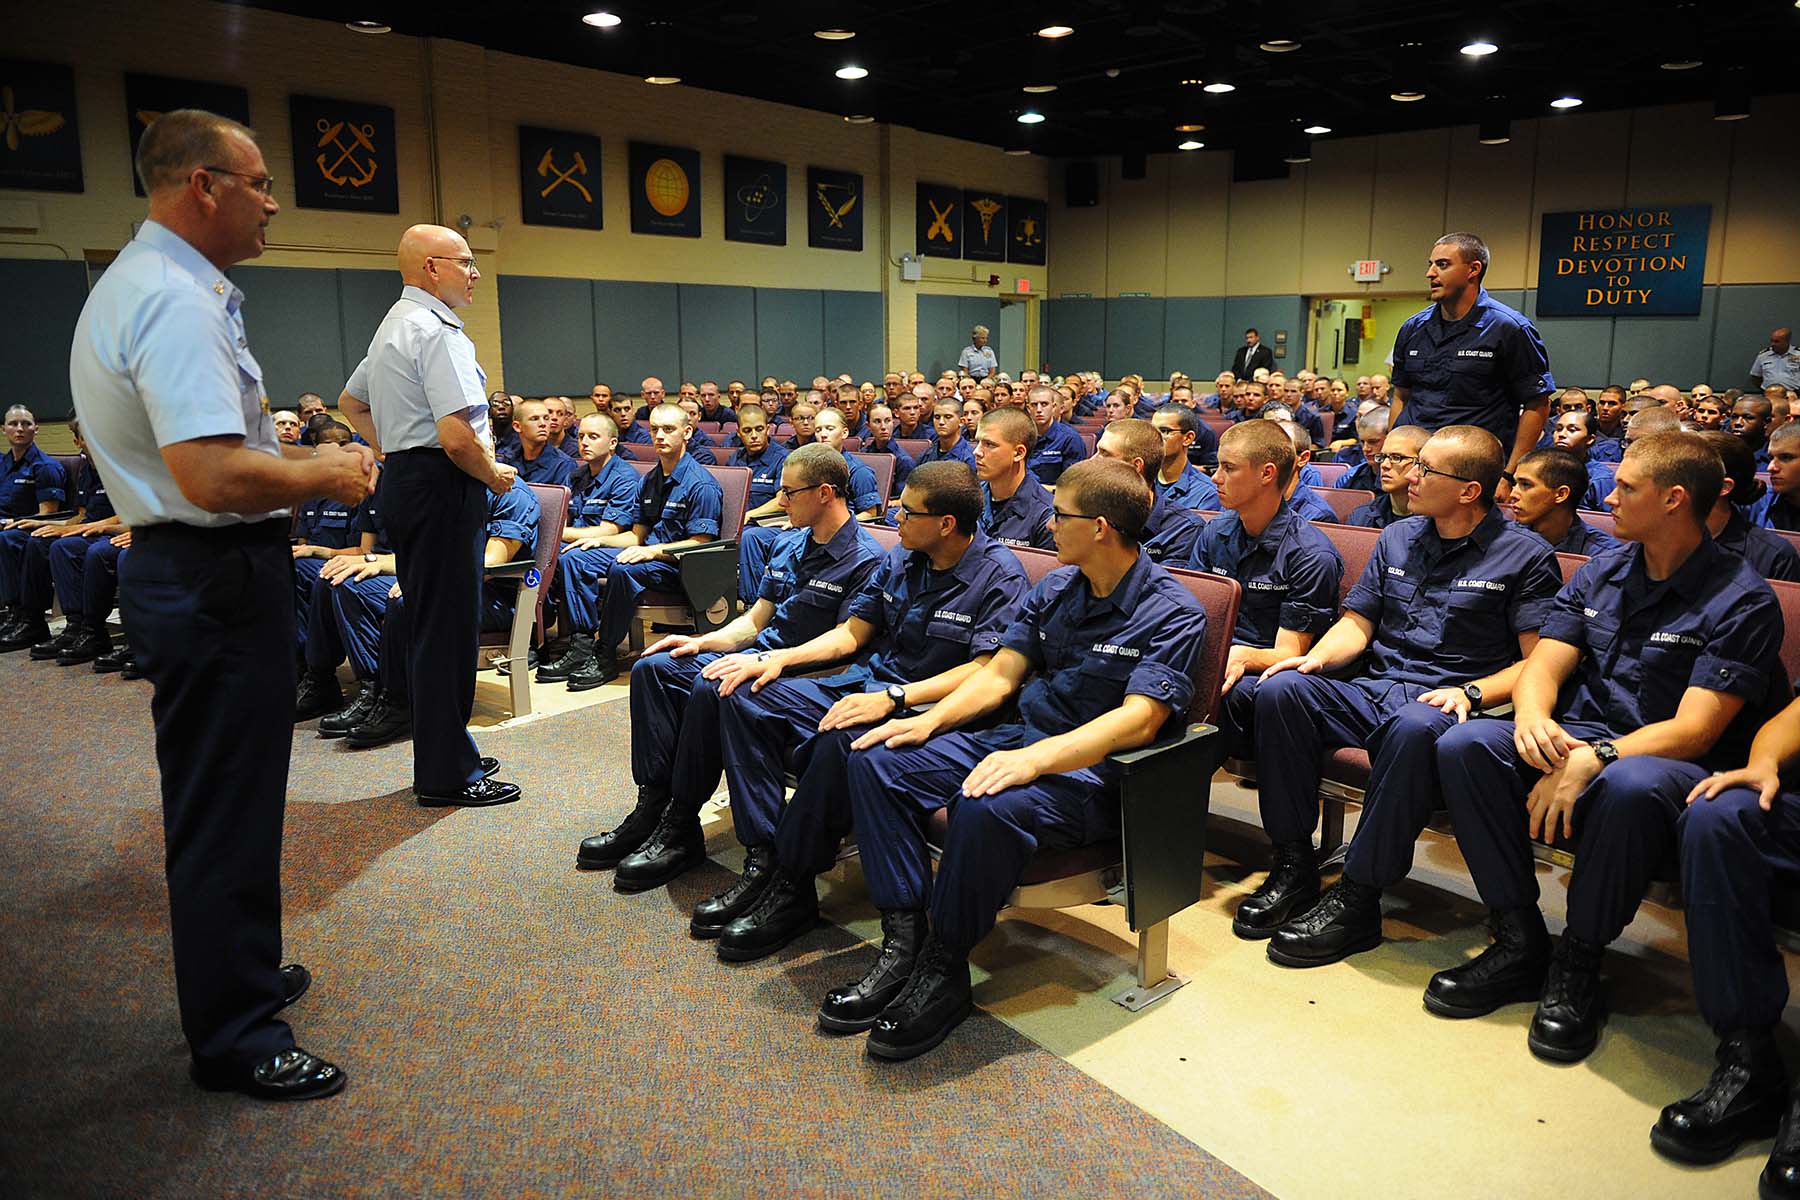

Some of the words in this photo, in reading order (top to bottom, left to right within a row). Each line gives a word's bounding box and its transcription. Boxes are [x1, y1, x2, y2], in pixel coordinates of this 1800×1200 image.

[1578, 211, 1673, 231] HONOR
[1573, 232, 1677, 253] RESPECT
[1359, 261, 1377, 275] EXIT
[1557, 255, 1688, 276] DEVOTION
[1605, 275, 1632, 288] TO
[1585, 288, 1653, 306] DUTY
[815, 580, 829, 589] COAST
[827, 583, 843, 593] GUARD
[1257, 582, 1273, 590] COAST
[1468, 580, 1486, 589] COAST
[1486, 581, 1506, 591] GUARD
[941, 611, 956, 620] COAST
[955, 614, 971, 623] GUARD
[1660, 632, 1681, 643] COAST
[1102, 644, 1119, 654] COAST
[1119, 647, 1140, 657] GUARD
